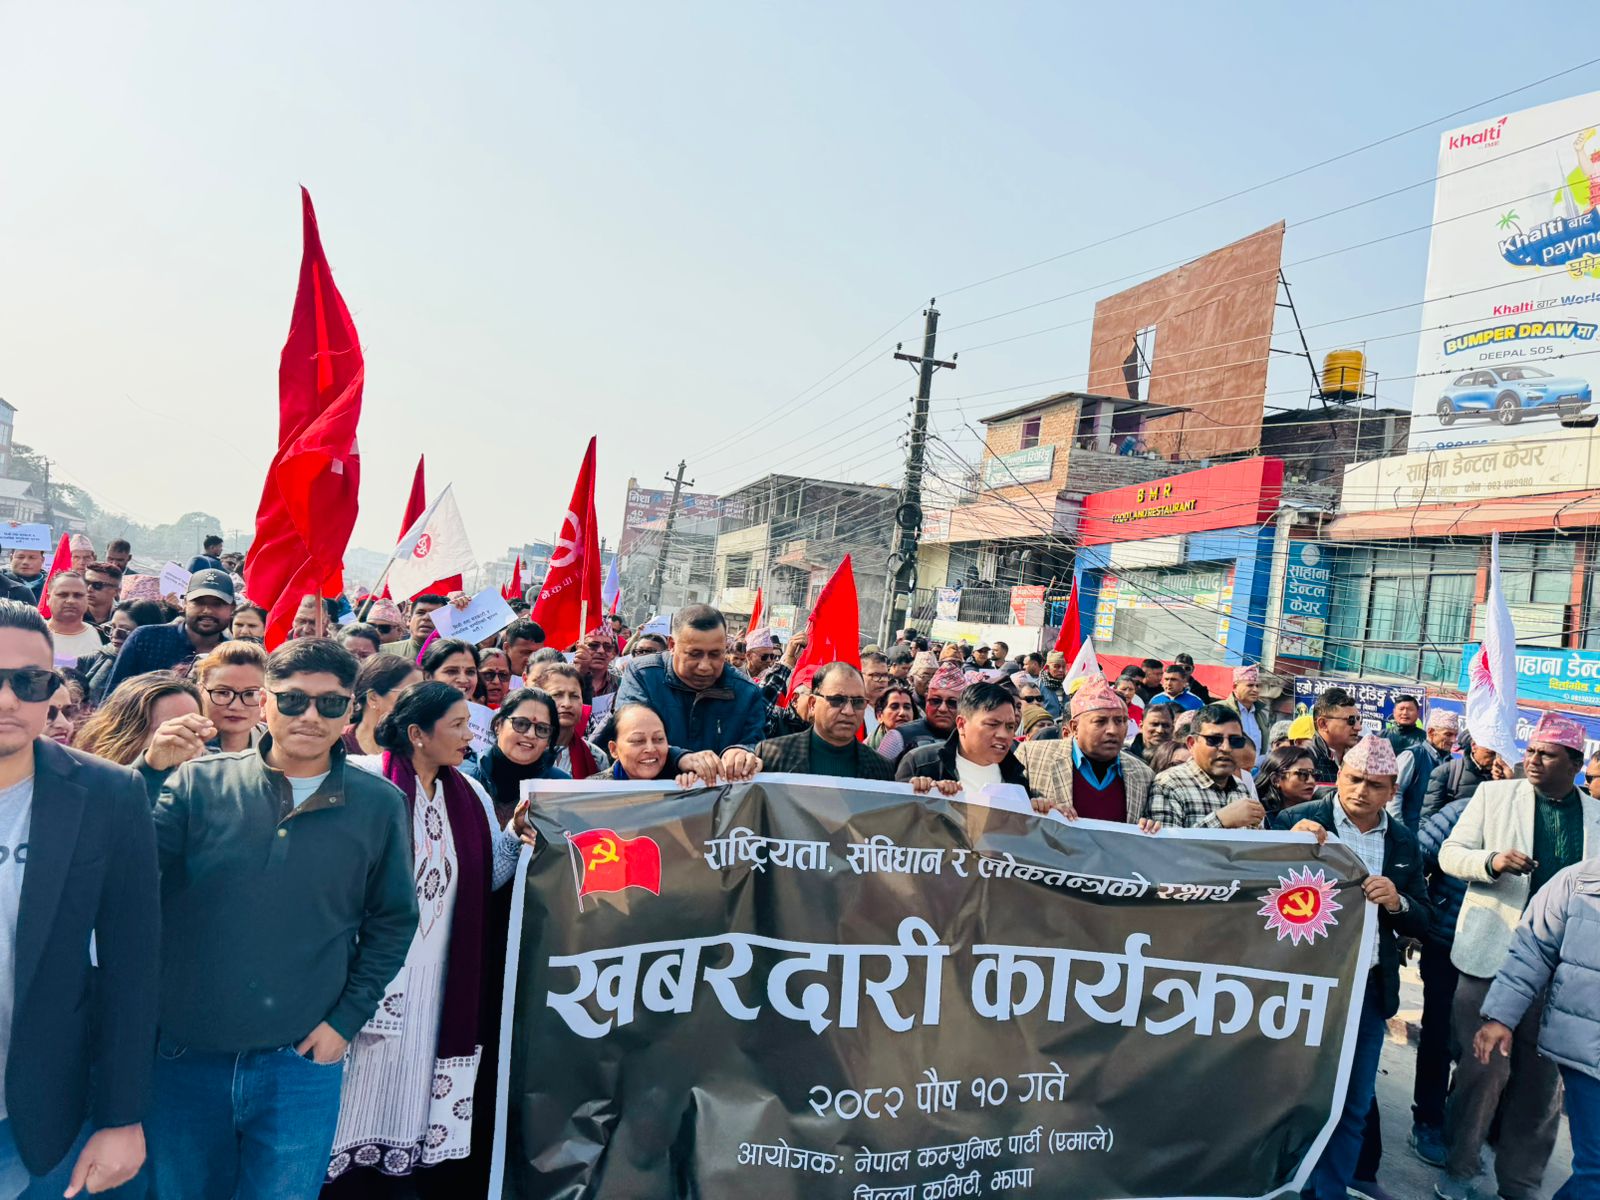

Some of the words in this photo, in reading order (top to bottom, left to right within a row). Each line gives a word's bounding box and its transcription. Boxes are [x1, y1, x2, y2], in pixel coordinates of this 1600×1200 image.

[1449, 122, 1503, 150] khalti
[1500, 217, 1563, 255] Khalti
[1493, 301, 1534, 316] Khalti
[1445, 325, 1516, 354] BUMPER
[1518, 322, 1576, 338] DRAW
[1480, 349, 1526, 361] DEEPAL
[1502, 444, 1548, 469] केयर
[1137, 488, 1146, 503] B
[1163, 482, 1173, 498] R
[1289, 564, 1331, 581] साहाना
[1289, 579, 1326, 597] डेन्टल
[1290, 596, 1322, 615] केयर
[703, 826, 834, 874] राष्ट्रियता,
[846, 834, 946, 876] संविधान
[951, 849, 972, 878] र
[1156, 879, 1241, 902] रक्षार्थ
[546, 916, 950, 1039] खबरदारी
[971, 933, 1339, 1047] कार्यक्रम
[808, 1085, 905, 1120] २०८२
[915, 1067, 962, 1114] पौष
[971, 1077, 1009, 1108] १०
[1018, 1061, 1070, 1102] गते
[737, 1138, 845, 1175] आयोजक:
[854, 1146, 912, 1173] नेपाल
[917, 1136, 1003, 1169] कम्युनिष्ट
[1008, 1125, 1044, 1155] पार्टी
[1048, 1125, 1114, 1155] (एमाले)
[922, 1170, 983, 1200] कमिटी,
[990, 1168, 1034, 1191] झापा
